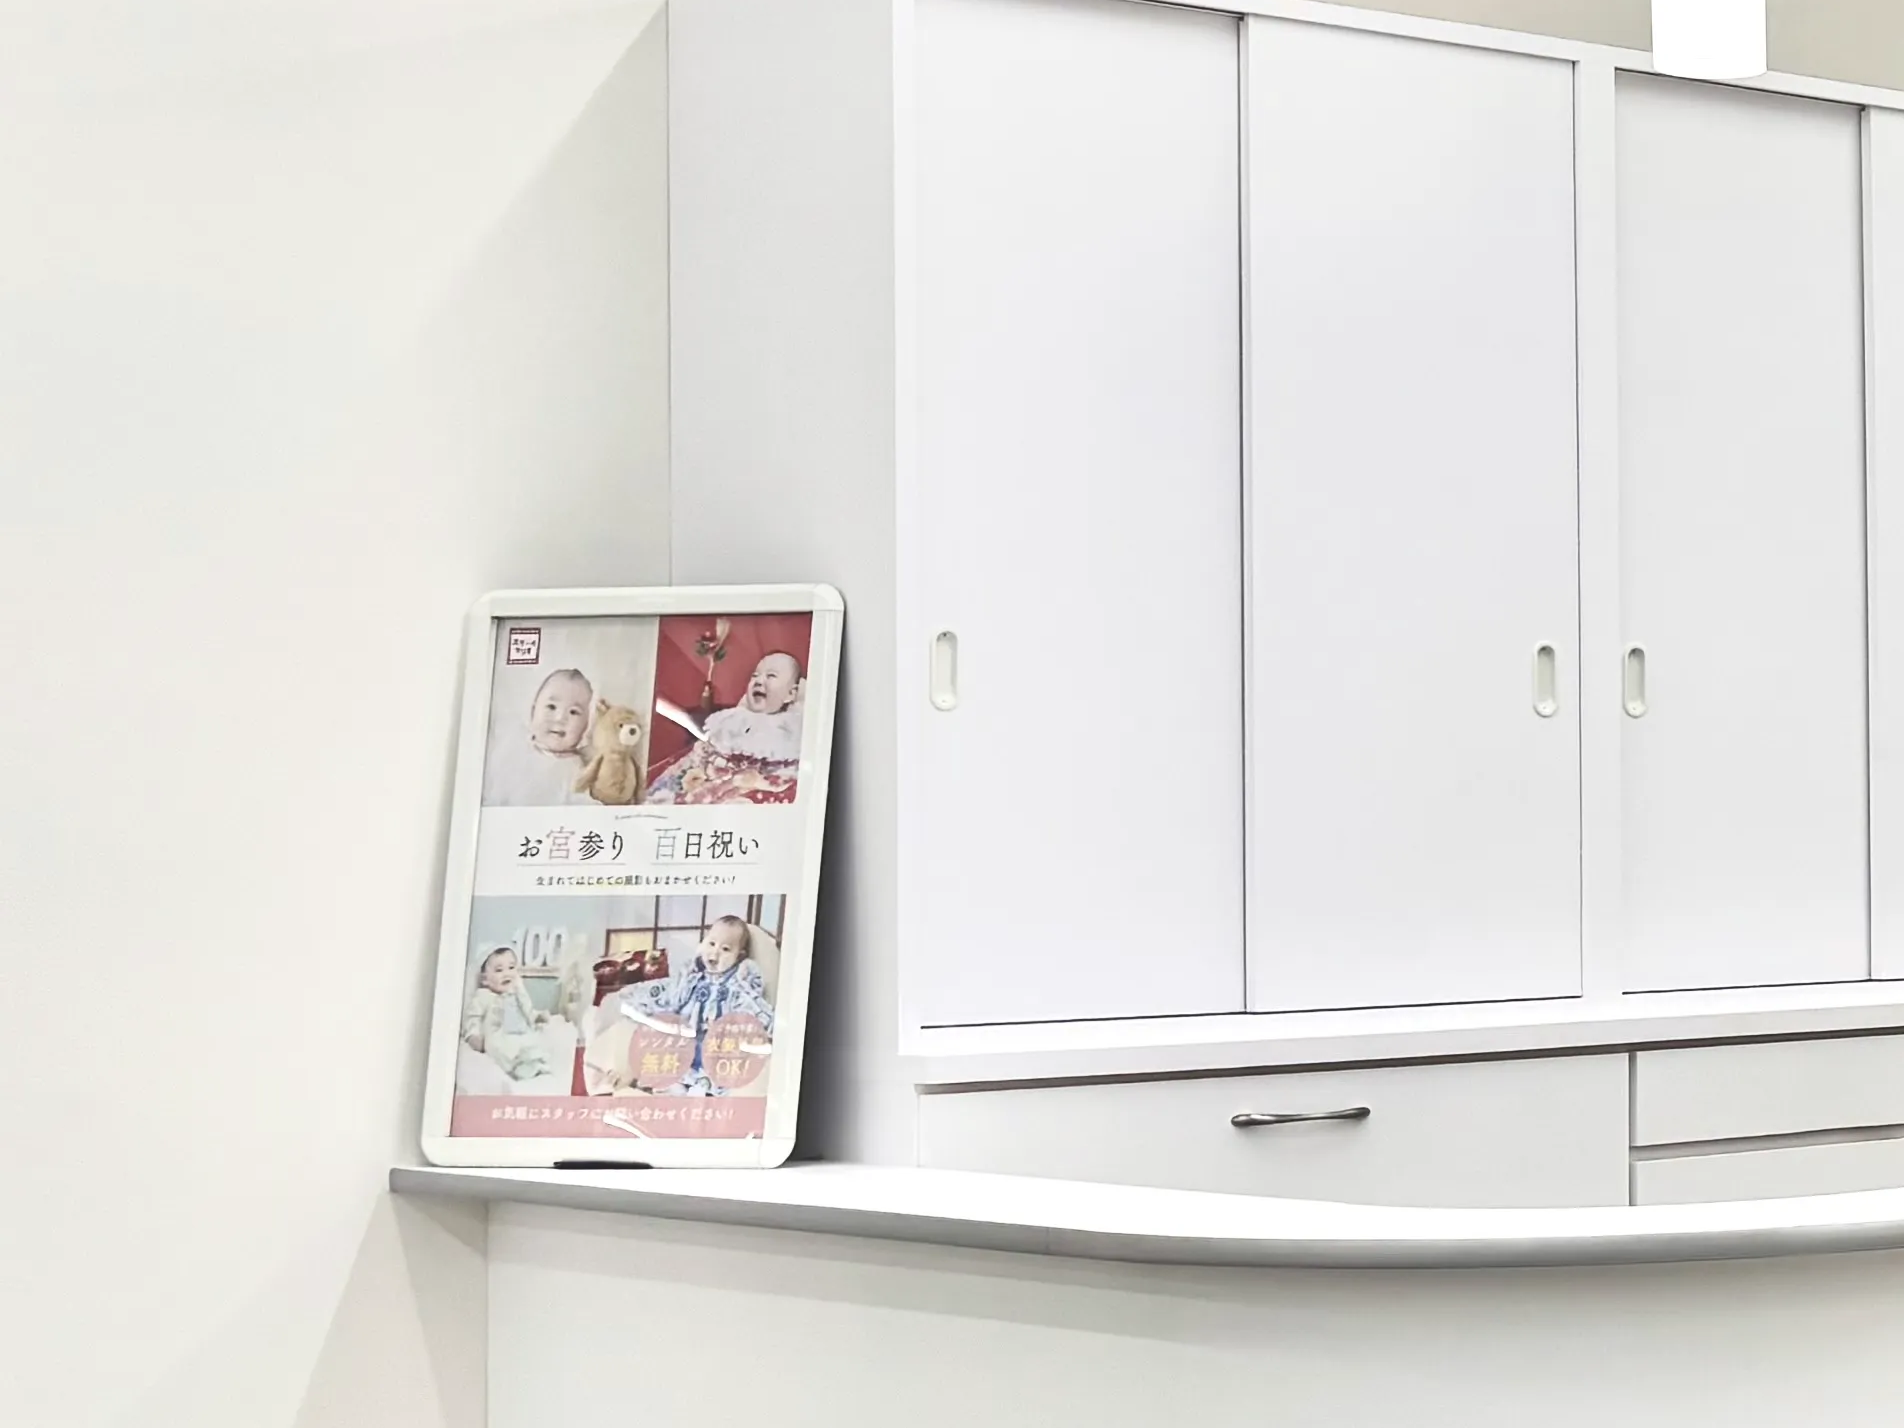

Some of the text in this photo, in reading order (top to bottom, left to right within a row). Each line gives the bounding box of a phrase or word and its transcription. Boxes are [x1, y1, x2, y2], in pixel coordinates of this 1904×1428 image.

[518, 826, 760, 861] お宮参り 百日祝い
